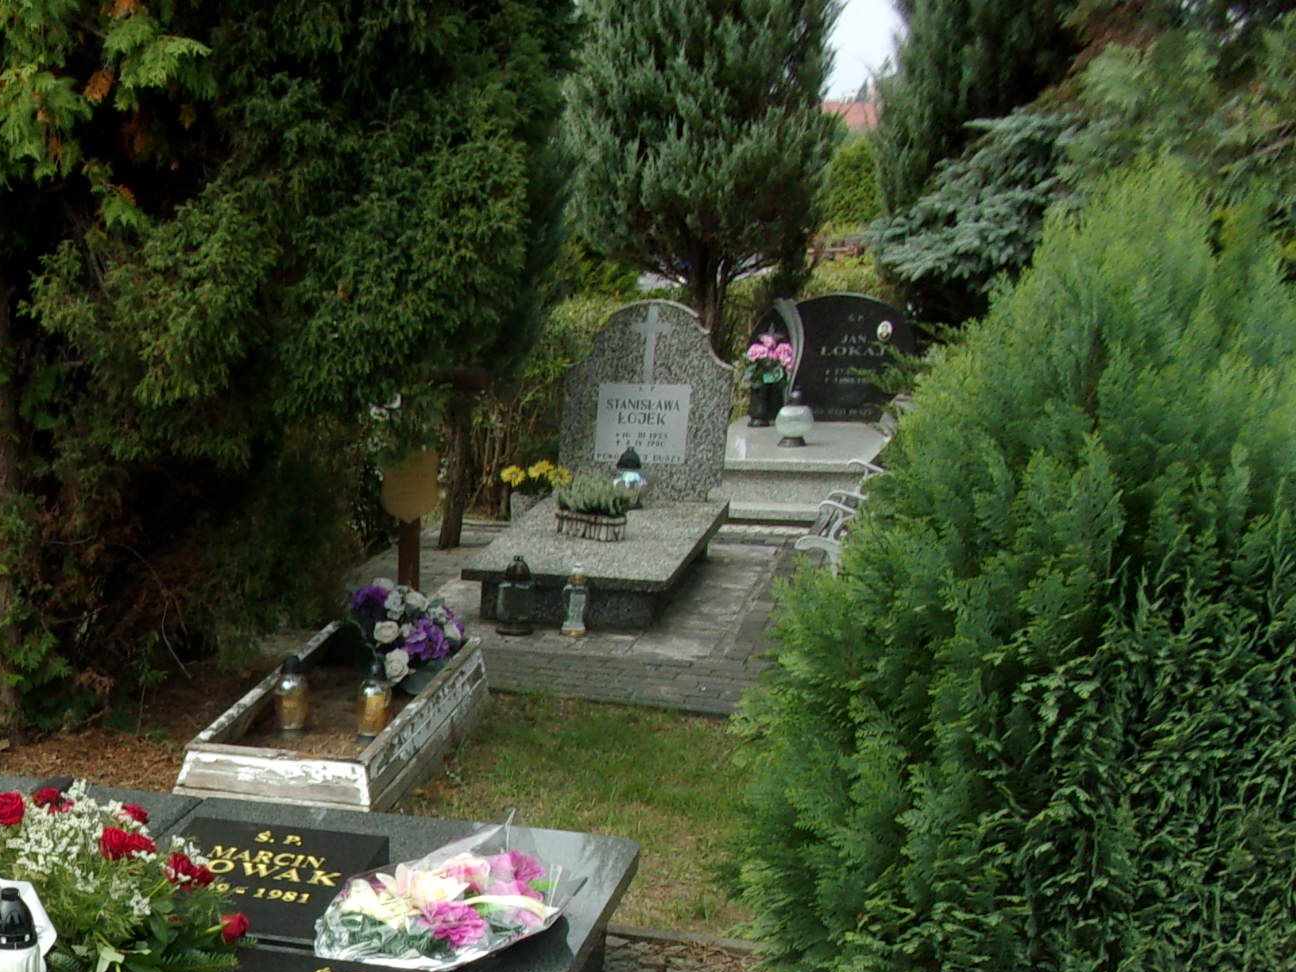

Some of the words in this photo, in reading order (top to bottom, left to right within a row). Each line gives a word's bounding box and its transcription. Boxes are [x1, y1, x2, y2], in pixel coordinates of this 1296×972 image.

[840, 334, 867, 344] JAN
[606, 399, 680, 411] STANISŁAWA
[617, 412, 666, 425] ŁOJEK
[255, 830, 275, 844] Ś.
[282, 834, 303, 846] P.
[206, 845, 326, 869] MARCIN
[207, 859, 342, 887] OWAK
[253, 888, 311, 904] 1981
